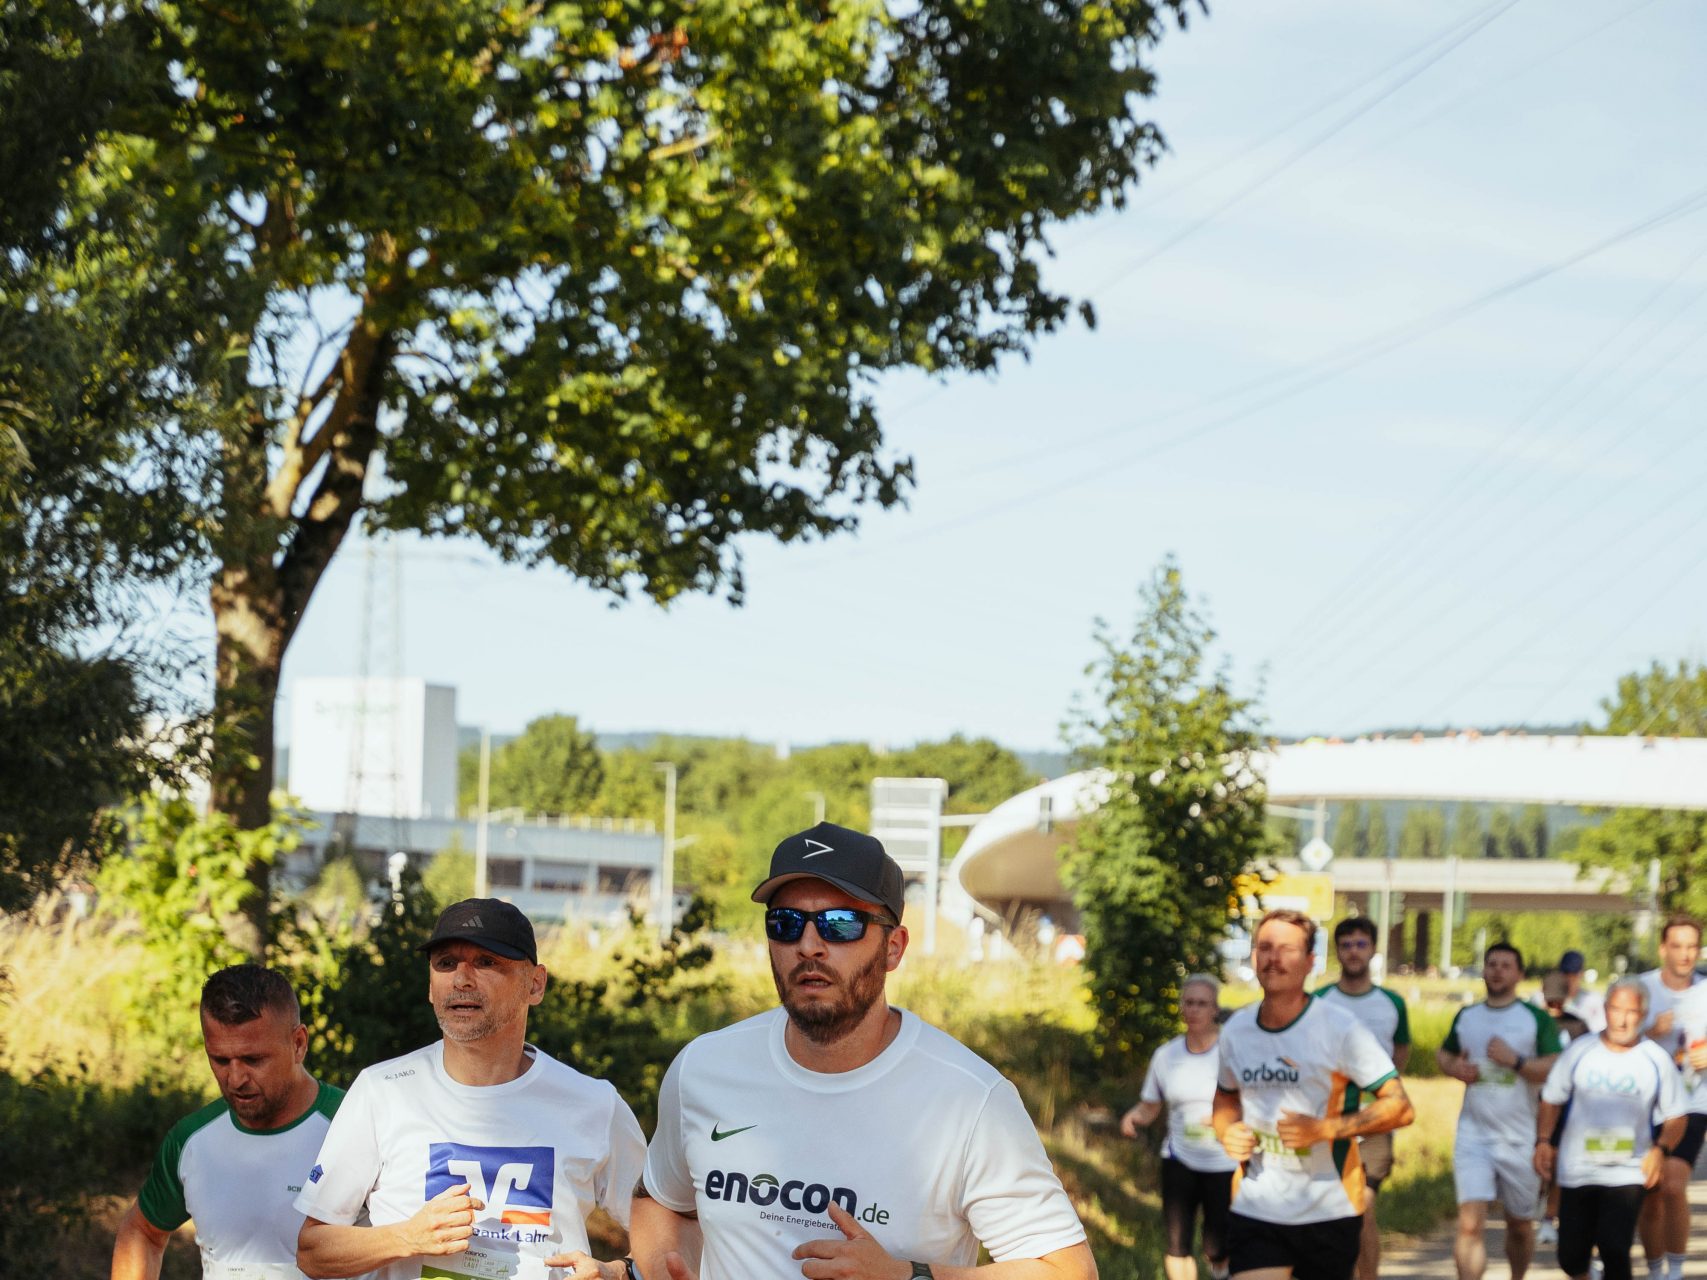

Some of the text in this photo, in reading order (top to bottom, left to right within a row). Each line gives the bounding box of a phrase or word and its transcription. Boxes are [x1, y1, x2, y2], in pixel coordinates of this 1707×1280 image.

[705, 1169, 890, 1225] enocon.de
[760, 1211, 785, 1223] Deine
[516, 1229, 549, 1243] Lahr
